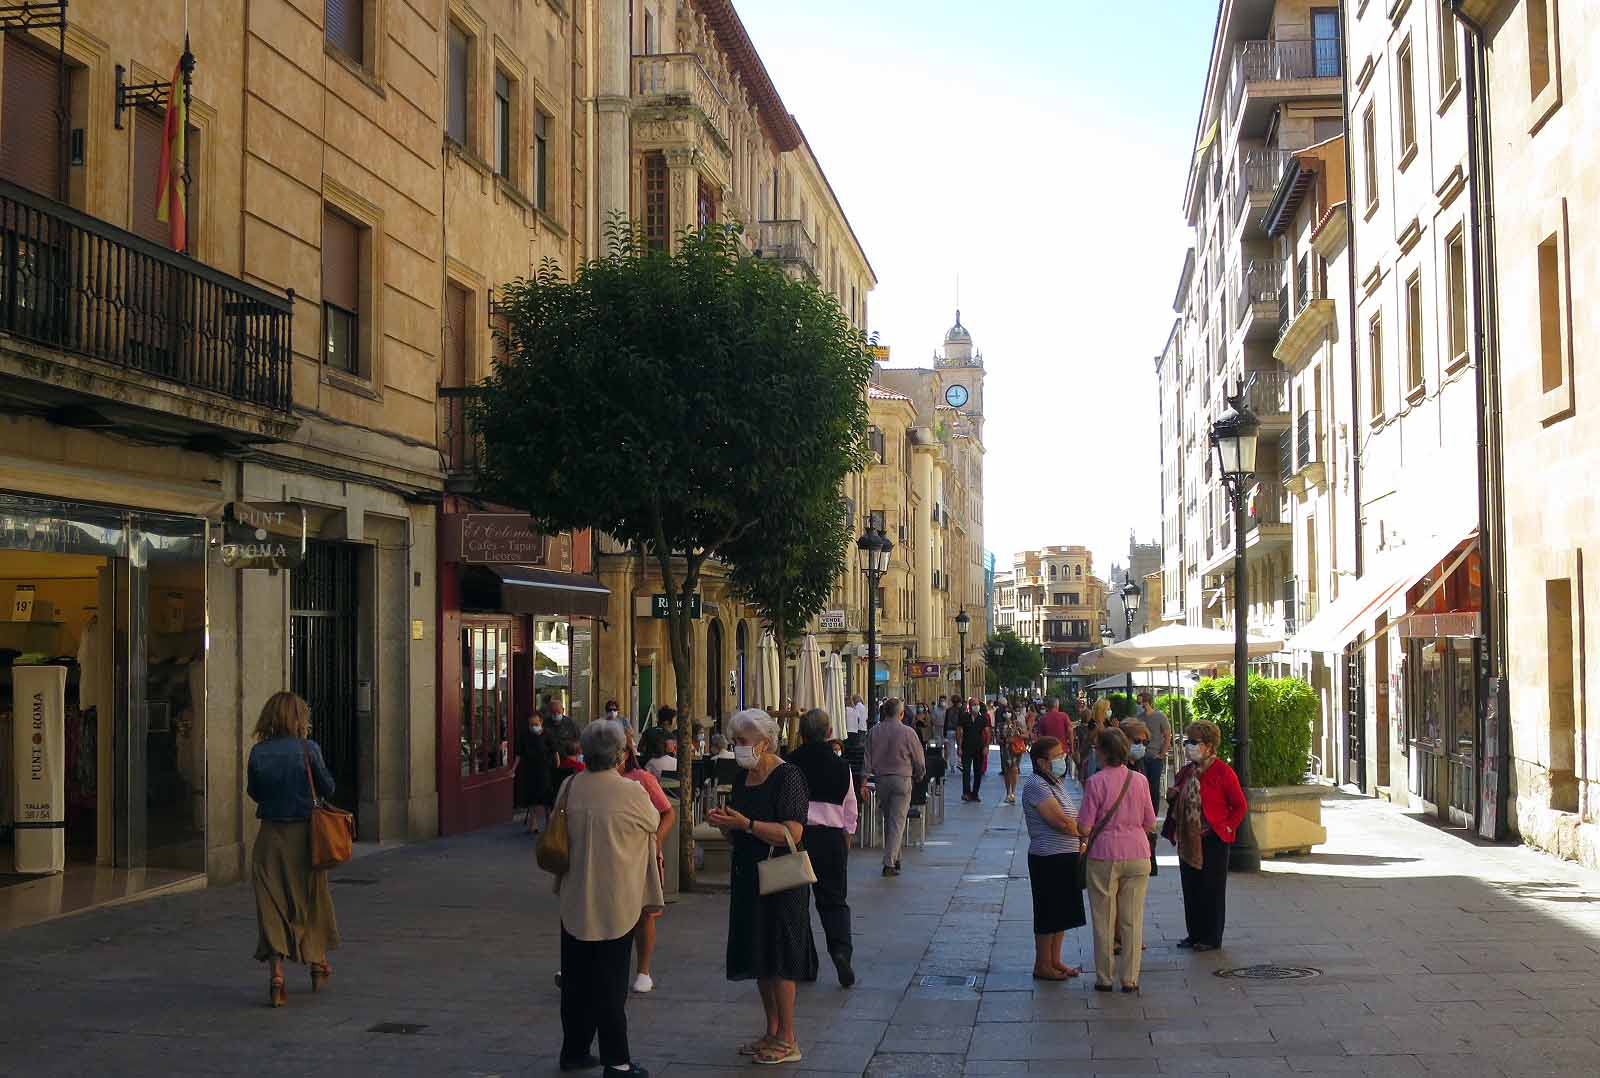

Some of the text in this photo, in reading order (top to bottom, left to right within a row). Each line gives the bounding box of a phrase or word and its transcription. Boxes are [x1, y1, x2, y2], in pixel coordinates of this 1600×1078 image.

[239, 512, 287, 526] PUNT
[509, 540, 537, 553] Tapas
[484, 550, 521, 561] Licores
[32, 692, 42, 781] PUNT ROMA
